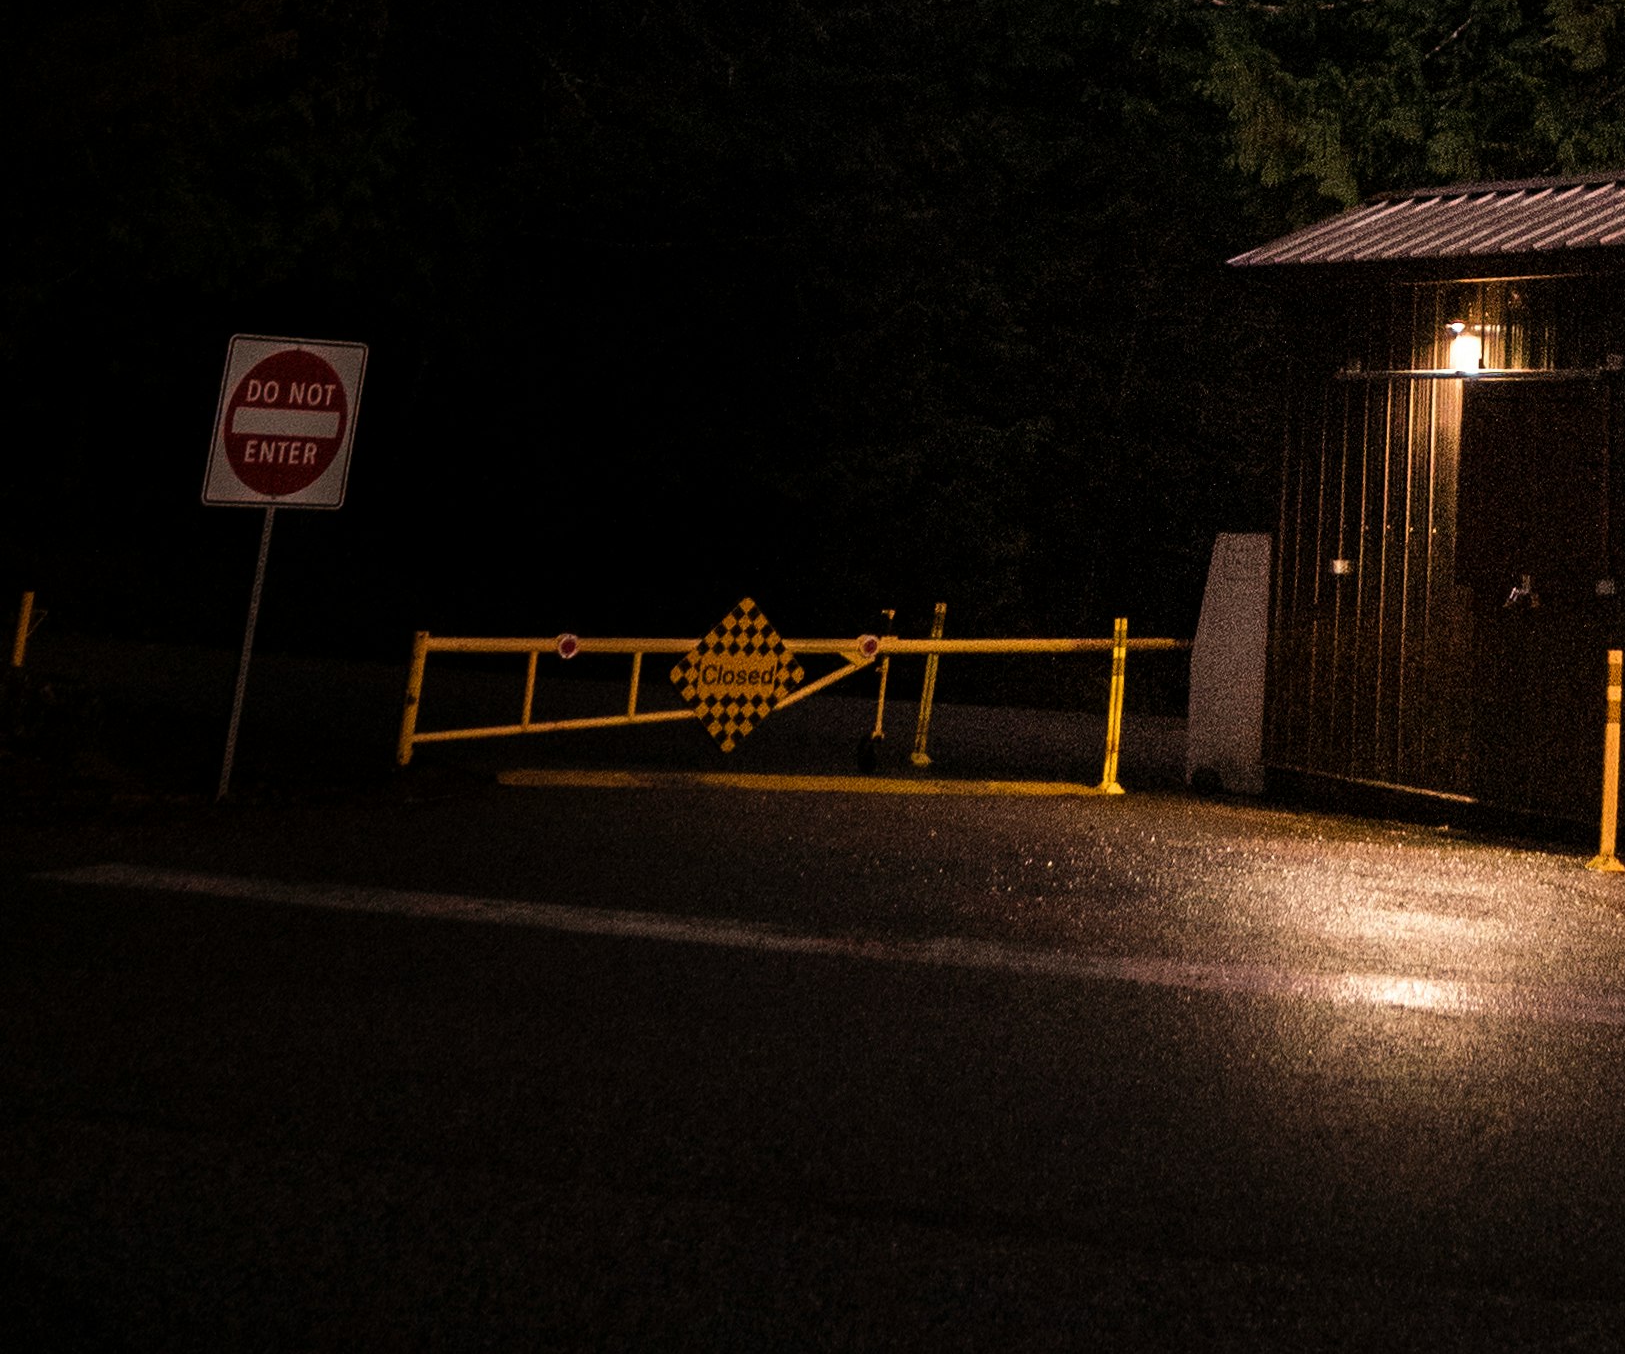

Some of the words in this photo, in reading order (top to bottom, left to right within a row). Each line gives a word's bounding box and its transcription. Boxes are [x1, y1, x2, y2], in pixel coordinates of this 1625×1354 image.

[246, 379, 280, 403] DO
[288, 381, 337, 406] NOT
[243, 439, 318, 465] ENTER
[702, 665, 775, 685] Closed
